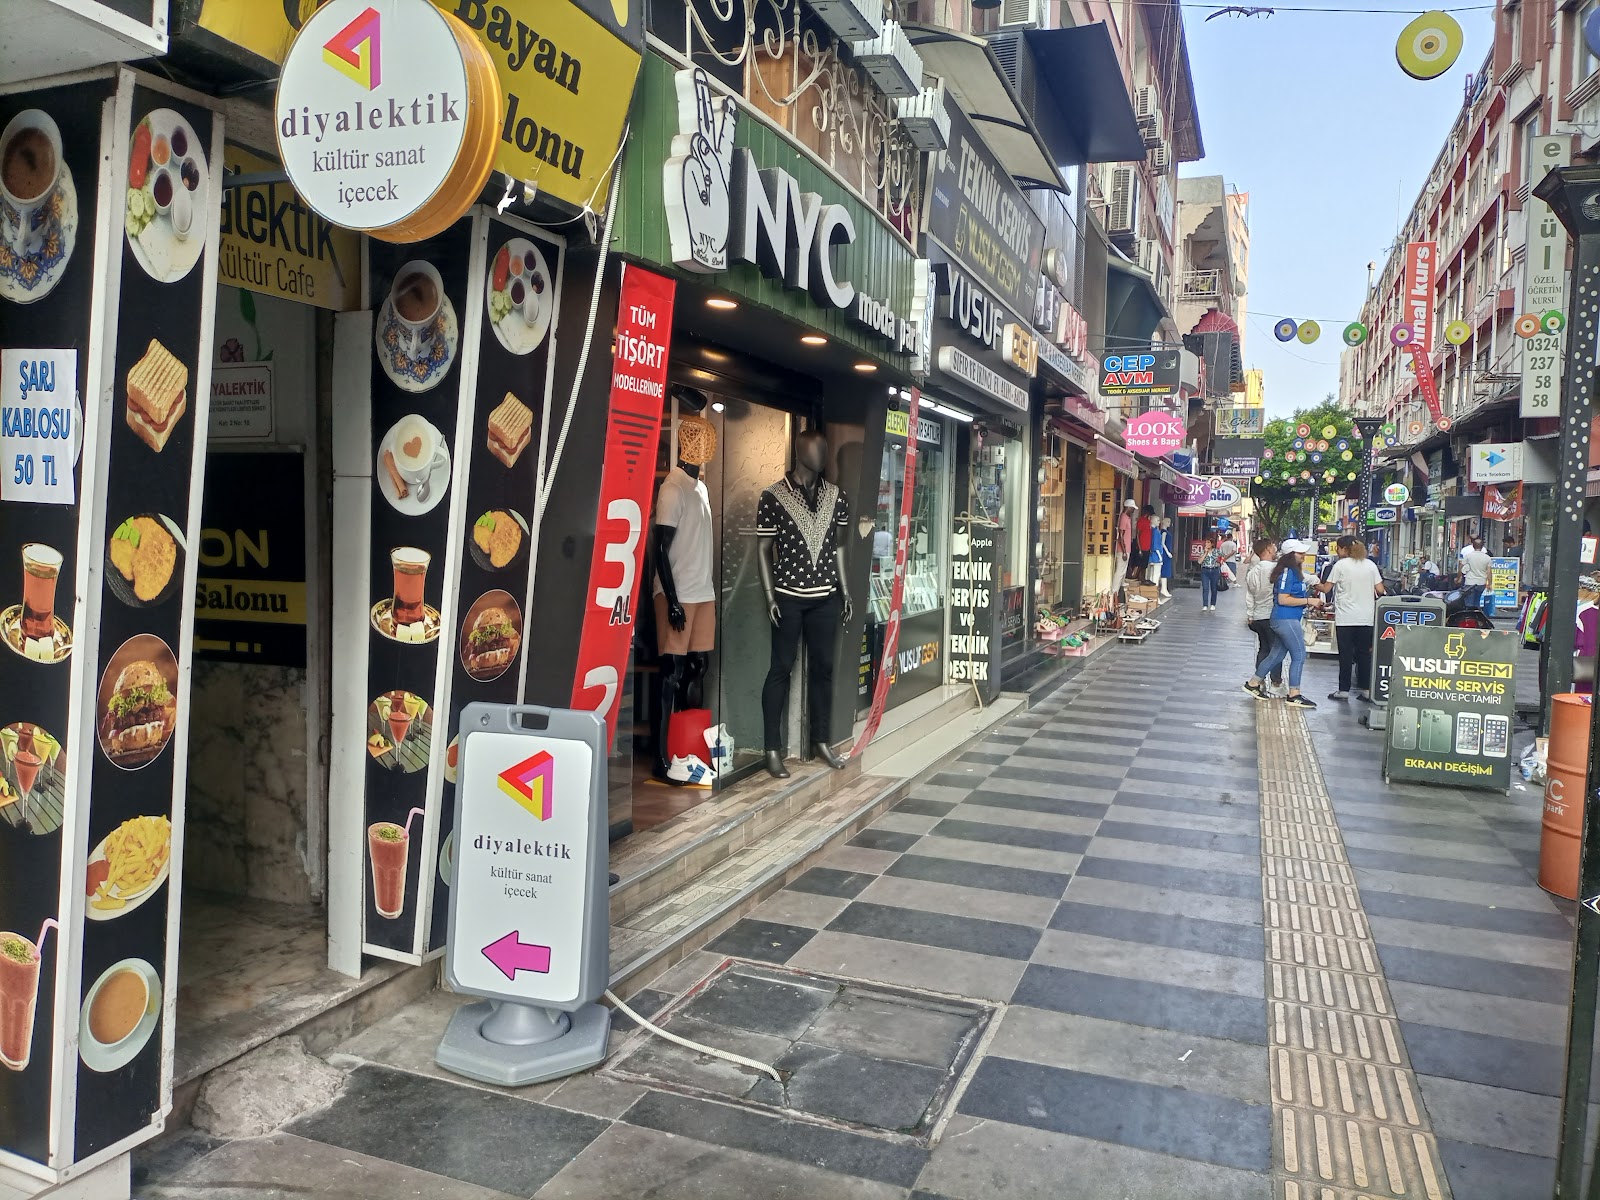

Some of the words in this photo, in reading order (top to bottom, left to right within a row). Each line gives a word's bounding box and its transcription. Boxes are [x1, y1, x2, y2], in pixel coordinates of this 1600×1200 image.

[281, 92, 460, 142] diyalektik
[312, 148, 369, 172] kültür
[375, 145, 426, 168] sanat
[338, 178, 399, 208] içecek
[957, 135, 1001, 230] TEKNİK
[998, 191, 1032, 264] SERVİS
[734, 148, 856, 309] NYC
[276, 257, 315, 298] Cafe
[1410, 246, 1431, 297] kurs
[1533, 275, 1556, 285] ÖZEL
[1527, 284, 1562, 295] ÖĞRETİM
[946, 264, 1003, 350] YUSUF
[1532, 296, 1556, 305] KURSU
[630, 304, 656, 330] TÜM
[858, 291, 896, 340] moda
[617, 329, 665, 369] TİŞÖRT
[1526, 337, 1560, 352] 0324
[1104, 355, 1156, 372] CEP
[1529, 356, 1555, 370] 237
[20, 360, 56, 400] ŞARJ
[613, 372, 663, 399] MODELLERİNDE
[1103, 371, 1154, 386] AVM
[1535, 375, 1552, 389] 58
[1531, 394, 1549, 408] 58
[2, 407, 71, 440] KABLOSU
[1127, 422, 1181, 437] LOOK
[1127, 438, 1150, 446] Shoes
[1152, 438, 1158, 446] &
[1160, 438, 1180, 446] Bags
[14, 454, 34, 485] 50
[42, 455, 58, 486] TL
[971, 536, 993, 549] Apple
[595, 498, 642, 609] 3
[608, 595, 632, 627] AL
[960, 612, 976, 627] ve
[1383, 610, 1437, 625] CEP
[1399, 655, 1460, 675] YUSUF
[1462, 662, 1511, 679] GSM
[1402, 675, 1452, 691] TEKNİK
[1455, 679, 1505, 695] SERVİS
[1405, 689, 1443, 701] TELEFON
[1445, 691, 1457, 701] VE
[1458, 693, 1470, 703] PC
[1471, 693, 1502, 705] TAMİRİ
[1404, 758, 1442, 771] EKRAN
[1445, 761, 1493, 777] DEĞİŞİMİ
[1546, 803, 1564, 816] park
[474, 834, 571, 860] diyalektik
[490, 865, 523, 881] kültür
[525, 870, 553, 884] sanat
[503, 884, 537, 899] içecek
